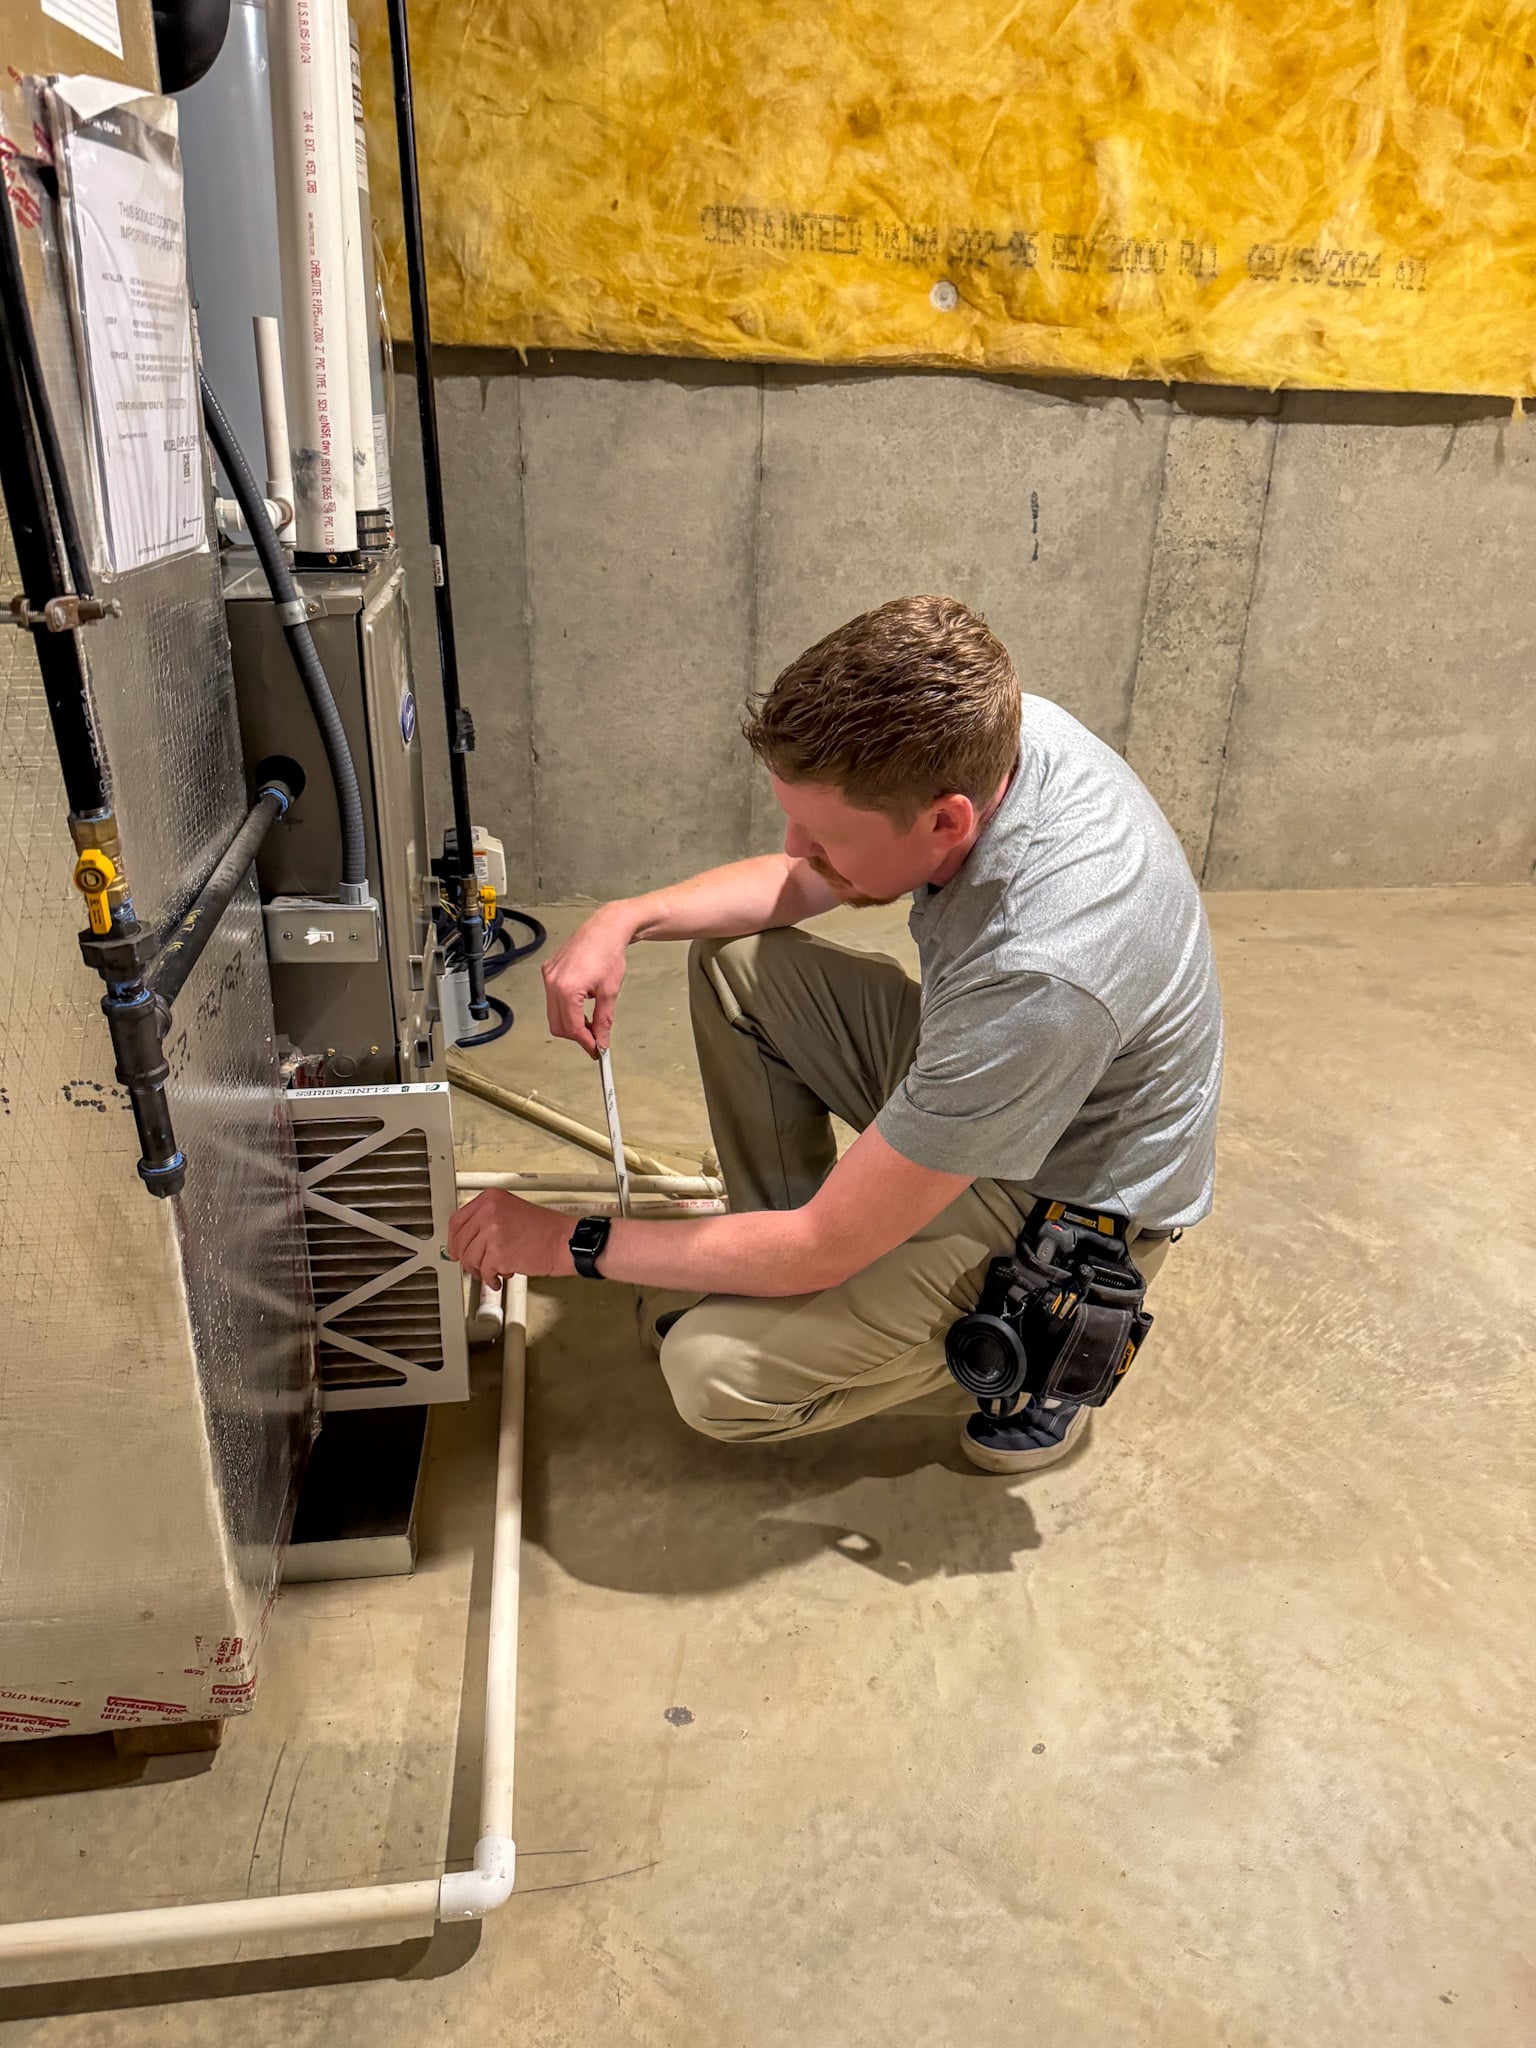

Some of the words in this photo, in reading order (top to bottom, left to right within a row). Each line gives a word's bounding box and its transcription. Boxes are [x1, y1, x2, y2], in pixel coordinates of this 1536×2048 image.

[310, 259, 321, 297] CHARLOTTE
[312, 298, 323, 316] PIPE
[315, 358, 326, 371] PVC
[316, 373, 327, 388] TYPE
[317, 399, 328, 411] SCH
[320, 458, 331, 474] ASTM
[323, 515, 334, 527] PVC
[295, 1088, 343, 1097] SERIES
[30, 1695, 82, 1708] WEATHER
